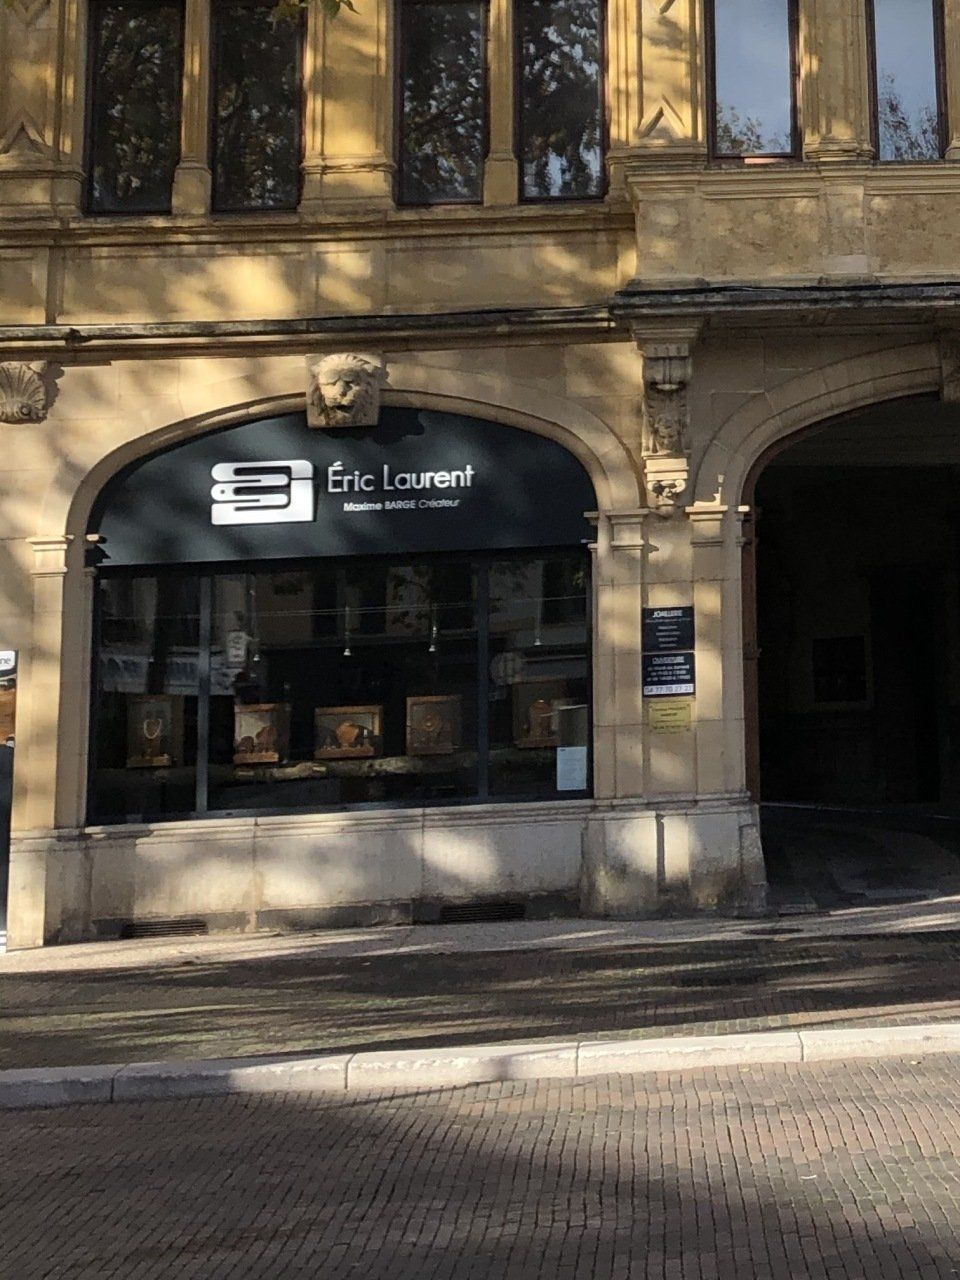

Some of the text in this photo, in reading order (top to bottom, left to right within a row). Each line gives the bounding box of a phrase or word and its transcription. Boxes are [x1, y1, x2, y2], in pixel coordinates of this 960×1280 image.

[327, 461, 476, 493] Éric Laurent
[343, 497, 460, 512] Maxime BARGE Créateur
